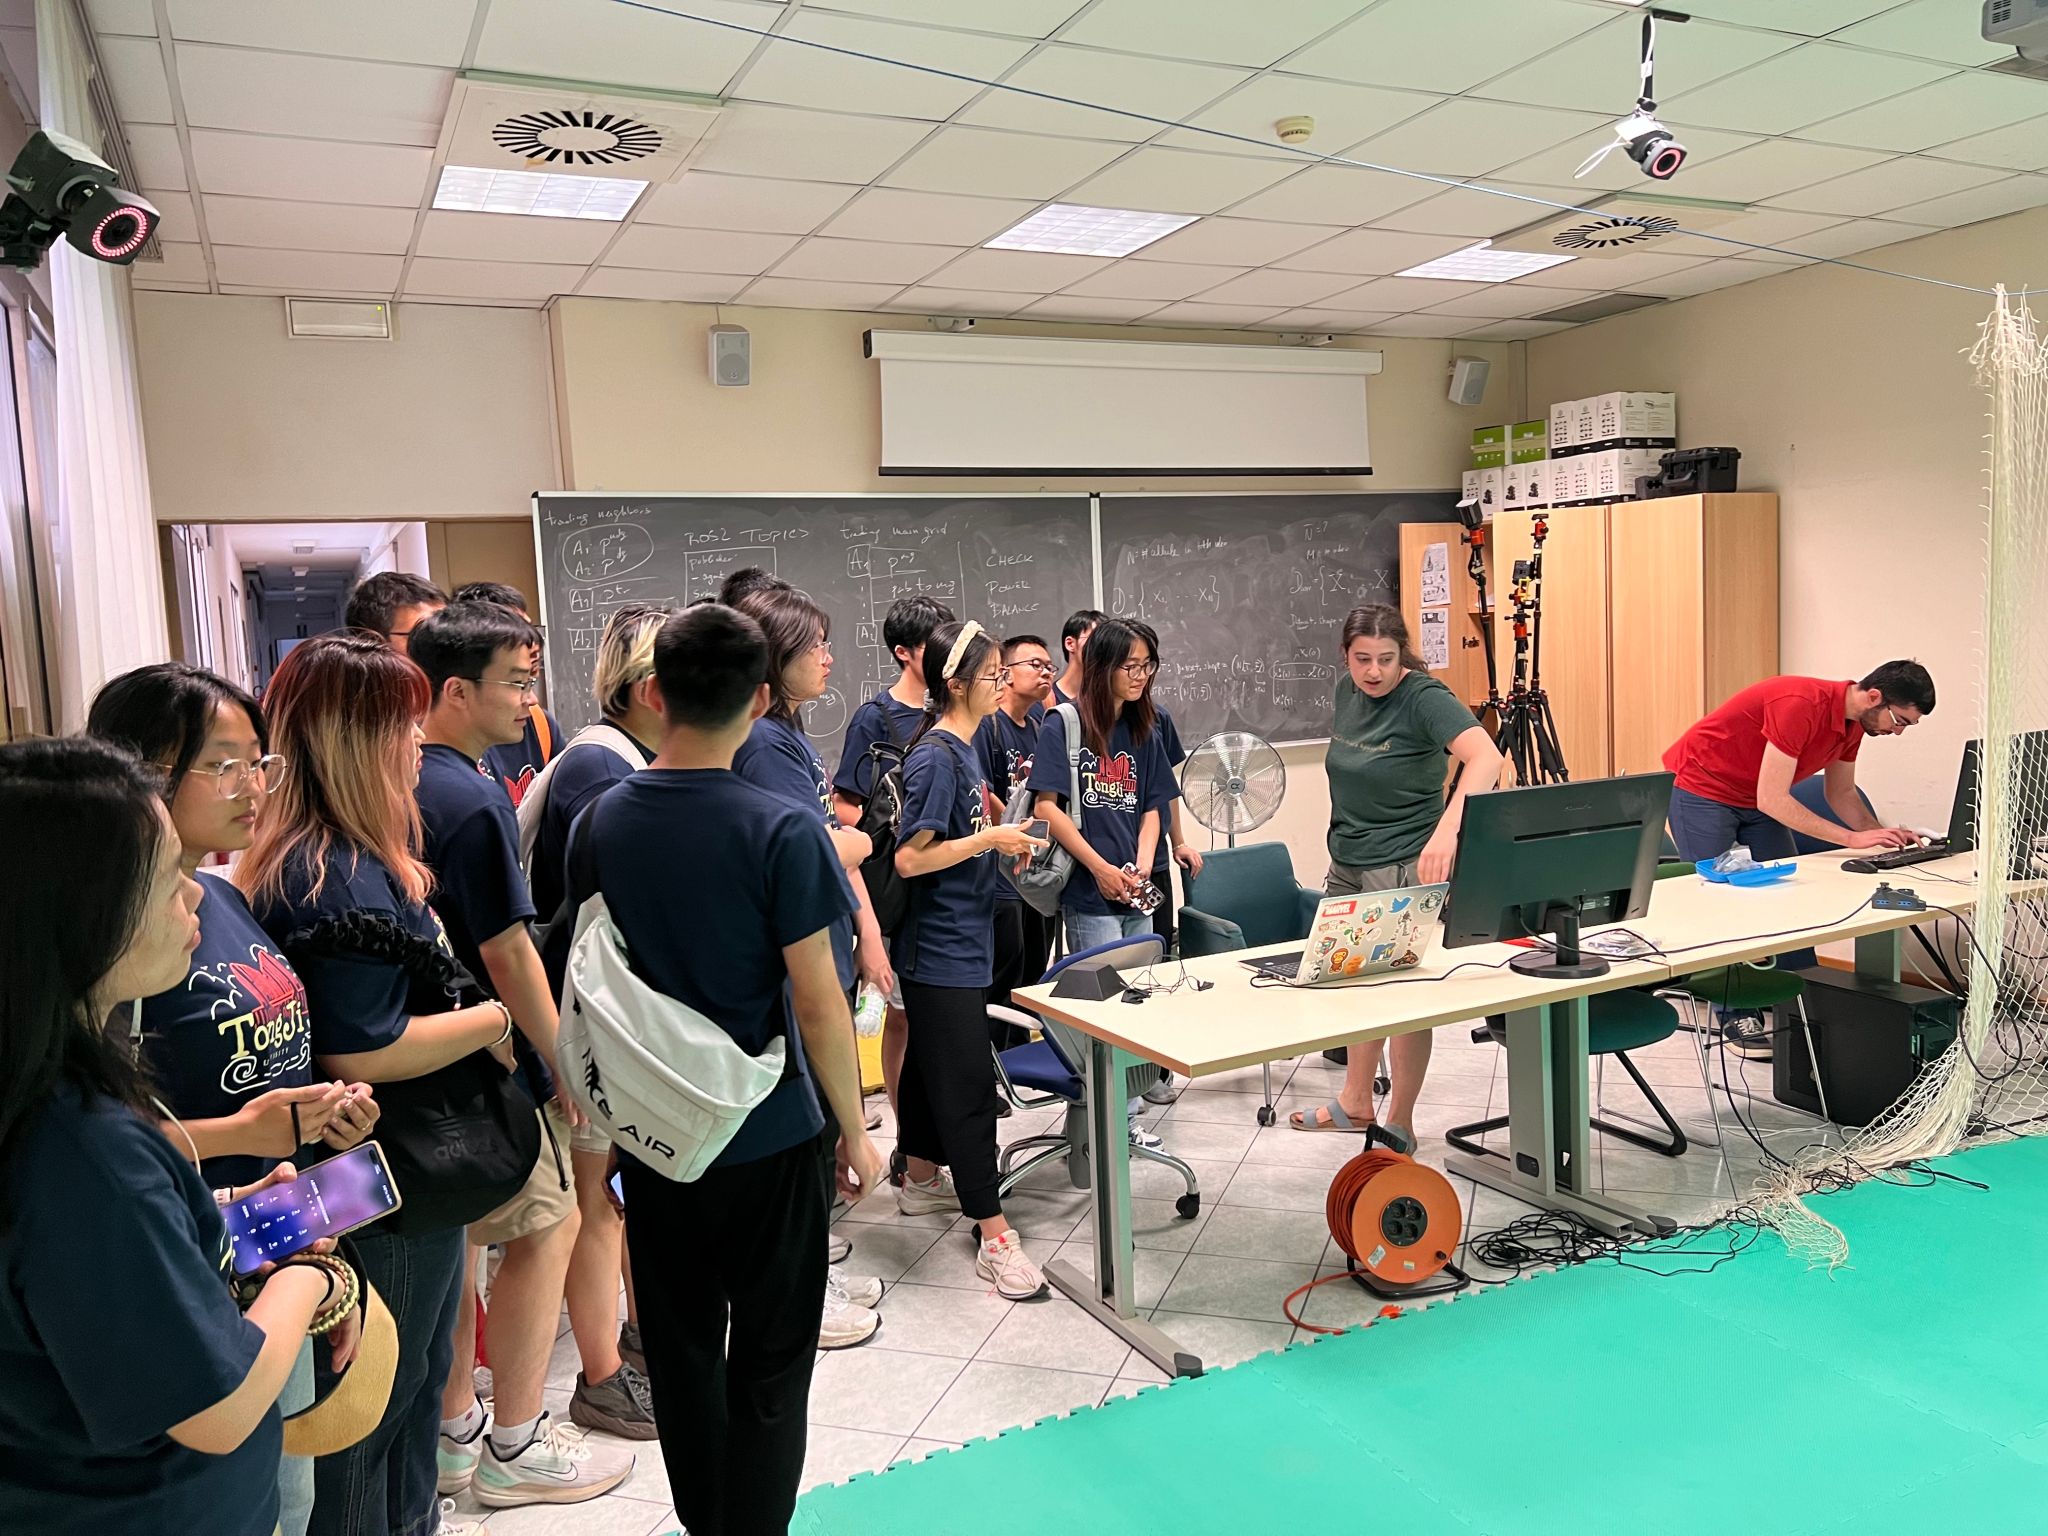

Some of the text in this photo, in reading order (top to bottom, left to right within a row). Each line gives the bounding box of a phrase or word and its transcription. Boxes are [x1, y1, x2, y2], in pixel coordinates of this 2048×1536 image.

[684, 527, 731, 546] ROS2
[986, 553, 1034, 568] CHECK
[989, 602, 1040, 618] BALANCE
[618, 1124, 676, 1161] AIR
